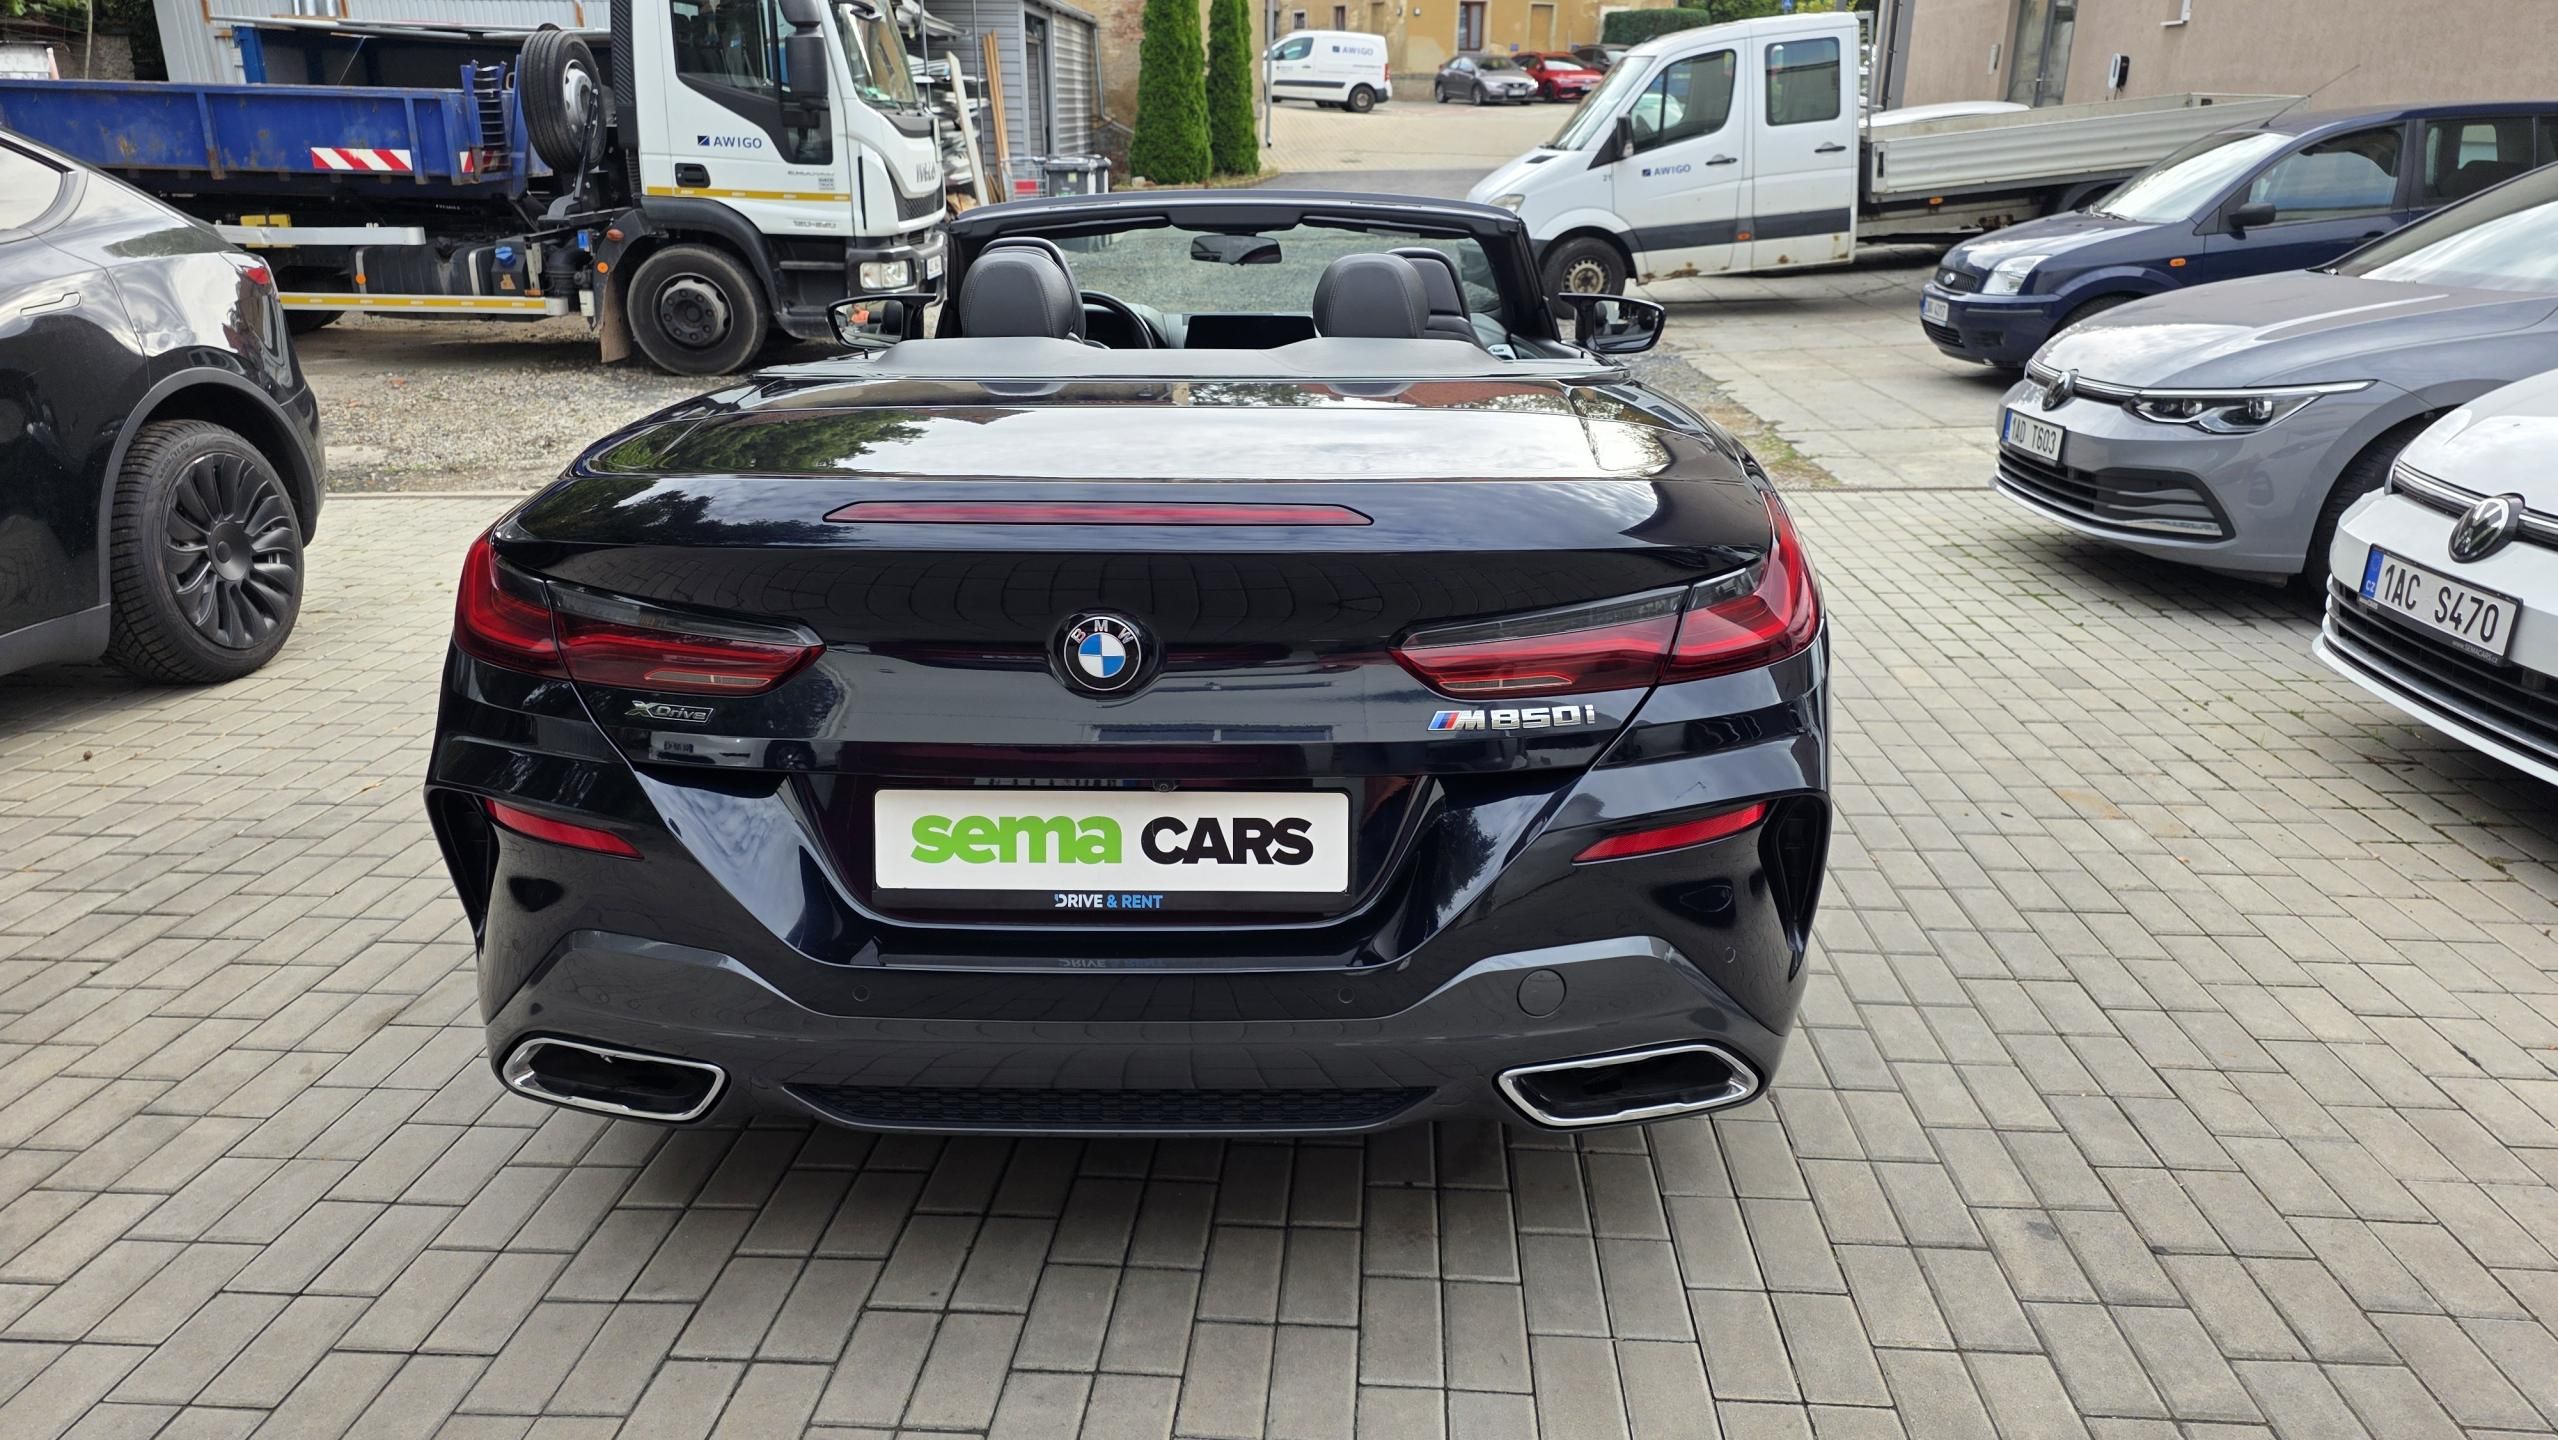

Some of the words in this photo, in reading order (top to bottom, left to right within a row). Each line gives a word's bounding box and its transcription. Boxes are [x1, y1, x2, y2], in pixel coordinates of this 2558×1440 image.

[1342, 47, 1374, 56] AWIGO
[714, 136, 762, 149] AWIGO
[1654, 164, 1691, 176] AWIGO
[2012, 417, 2027, 443] 1AD
[2032, 424, 2057, 454] T603
[2365, 580, 2376, 593] CZ
[2384, 564, 2421, 610] 1AC
[2434, 586, 2500, 643] S470
[1071, 619, 1134, 644] BMW
[1454, 704, 1596, 731] M850i
[911, 815, 1122, 865] sema
[1141, 816, 1314, 865] CARS
[1055, 893, 1103, 908] DRIVE
[1106, 894, 1118, 908] &
[1121, 894, 1163, 909] RENT
